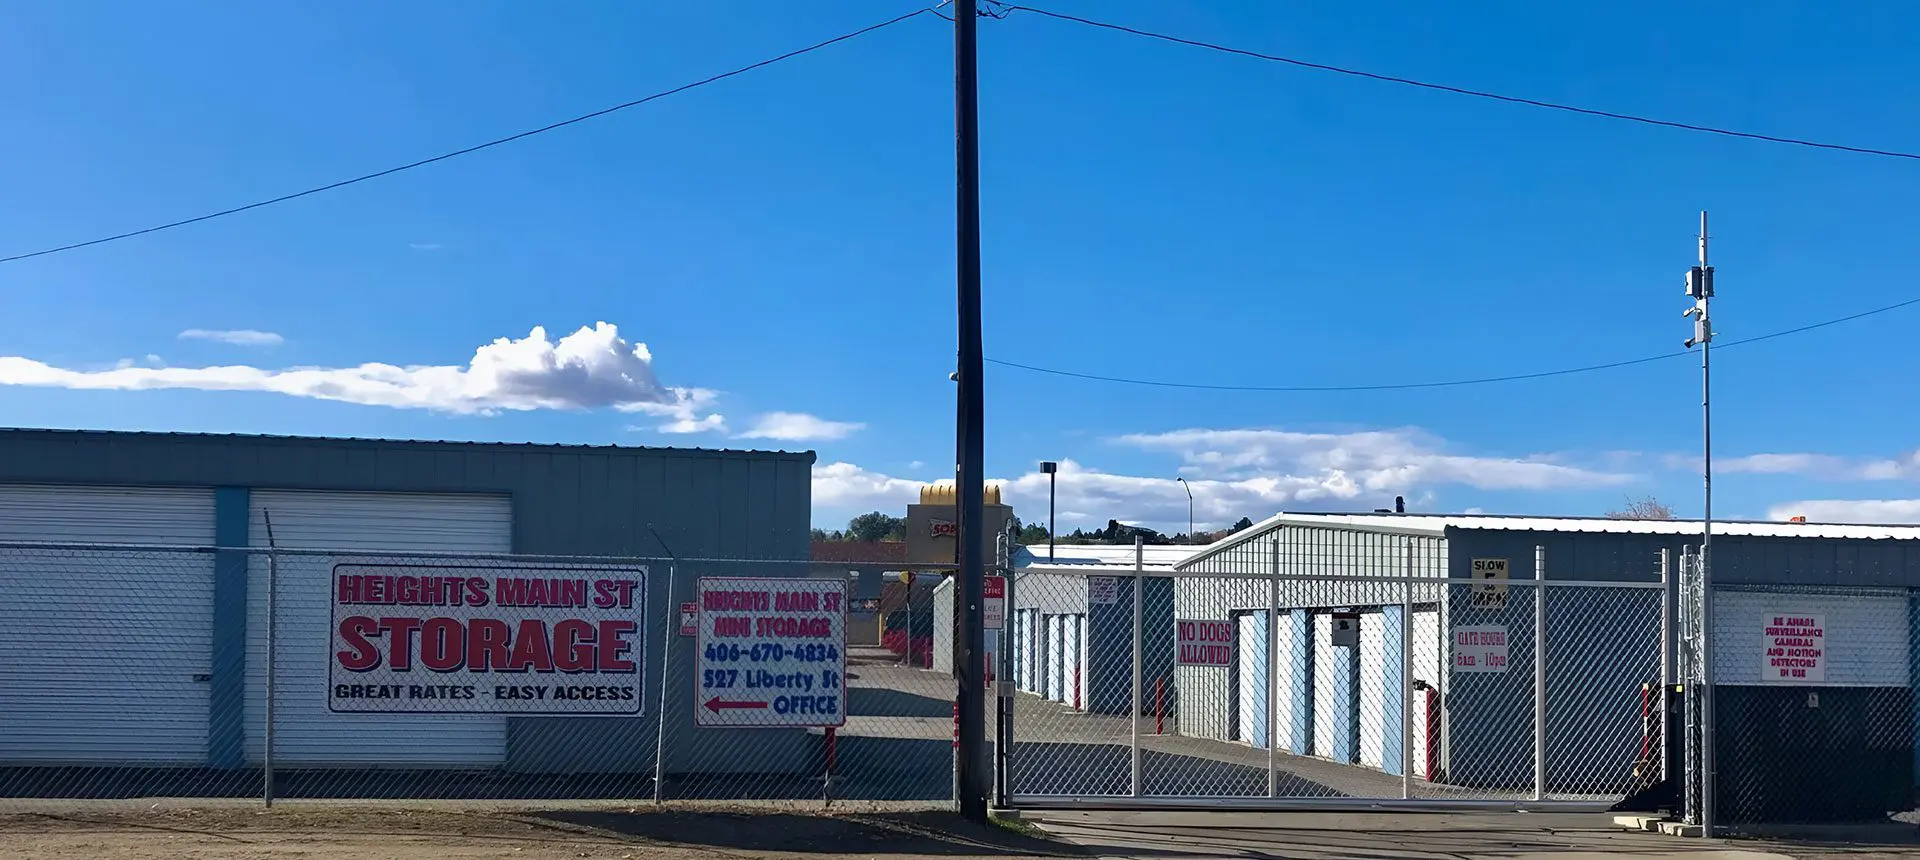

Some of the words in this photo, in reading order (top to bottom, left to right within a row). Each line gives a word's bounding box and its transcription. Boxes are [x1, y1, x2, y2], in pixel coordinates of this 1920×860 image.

[1474, 560, 1505, 571] SLOW
[338, 575, 489, 606] HEIGHTS
[495, 577, 588, 608] MAIN
[593, 579, 638, 608] ST
[703, 591, 770, 612] HEIGHTS
[774, 592, 819, 612] MAIN
[823, 592, 841, 613] ST
[714, 617, 751, 638] MINI
[756, 617, 832, 638] STORAGE
[1774, 617, 1784, 626] BE
[1787, 617, 1815, 627] AWARE
[1179, 622, 1196, 641] NO
[1200, 622, 1231, 642] DOGS
[1458, 632, 1479, 645] GATE
[1765, 628, 1823, 637] SURVEILLANCE
[336, 616, 637, 673] STORAGE
[1775, 638, 1814, 647] CAMERAS
[704, 643, 839, 662] 406-670-4834
[1179, 644, 1231, 665] ALLOWED
[1767, 648, 1784, 656] AND
[1787, 648, 1821, 658] MOTION
[1771, 658, 1816, 668] DETECTORS
[703, 669, 739, 689] 527
[746, 669, 814, 692] Liberty
[822, 670, 839, 689] St
[1780, 669, 1789, 677] IN
[1792, 669, 1806, 678] USE
[335, 684, 403, 700] GREAT
[408, 685, 475, 700] RATES
[495, 686, 548, 701] EASY
[553, 686, 634, 701] ACCESS
[773, 695, 838, 715] OFFICE
